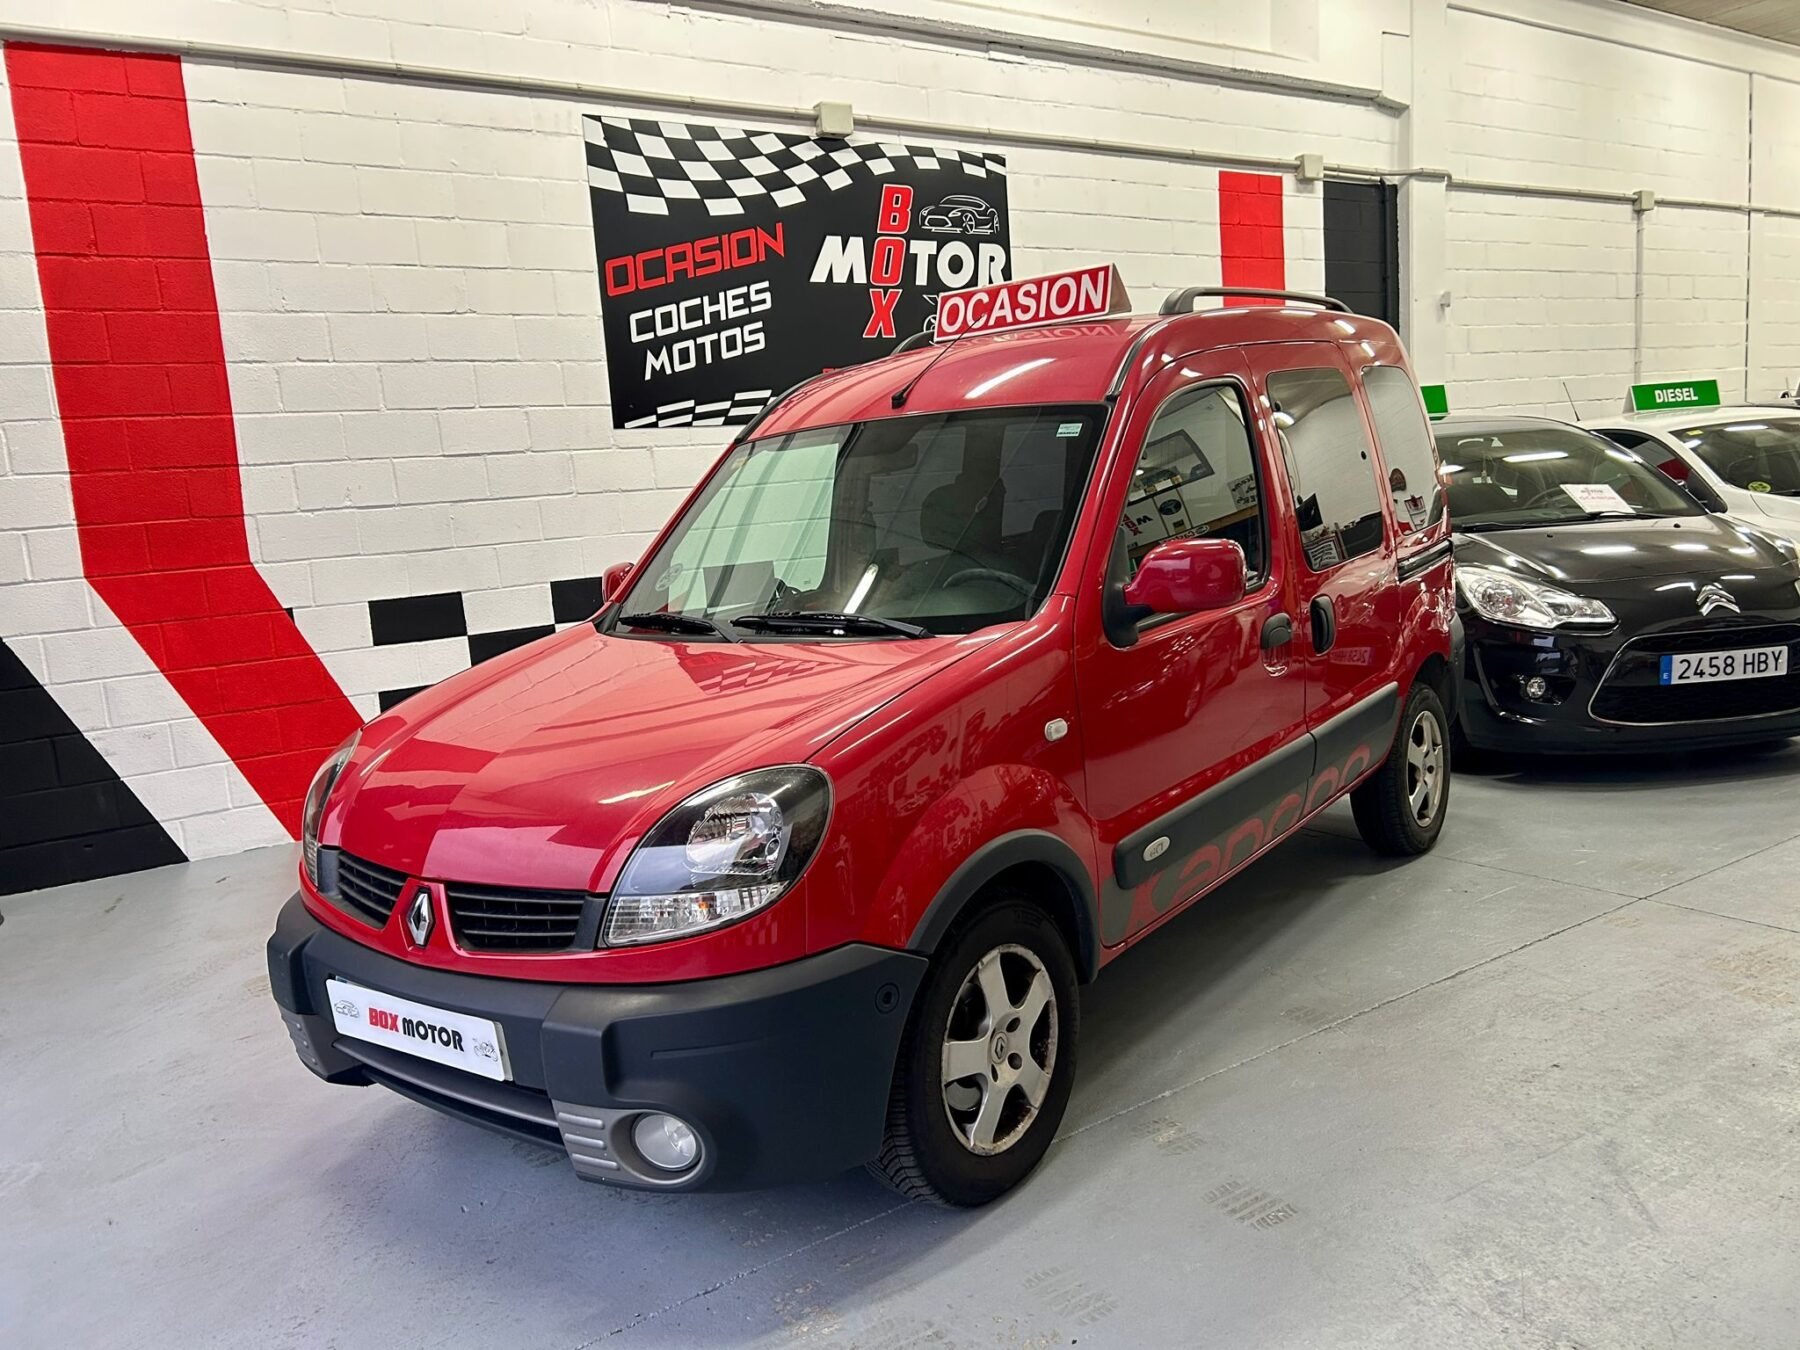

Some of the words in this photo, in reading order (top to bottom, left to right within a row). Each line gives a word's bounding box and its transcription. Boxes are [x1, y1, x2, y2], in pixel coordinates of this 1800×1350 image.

[605, 222, 785, 297] OCASION
[863, 183, 914, 339] BOX
[629, 280, 772, 344] COCHES
[941, 270, 1105, 333] OCASION
[644, 320, 766, 381] MOTOS
[1654, 387, 1699, 404] DIESEL
[1678, 655, 1735, 680] 2458
[1743, 650, 1783, 674] HBY
[369, 1008, 399, 1032] BOX
[403, 1018, 464, 1052] MOTOR
